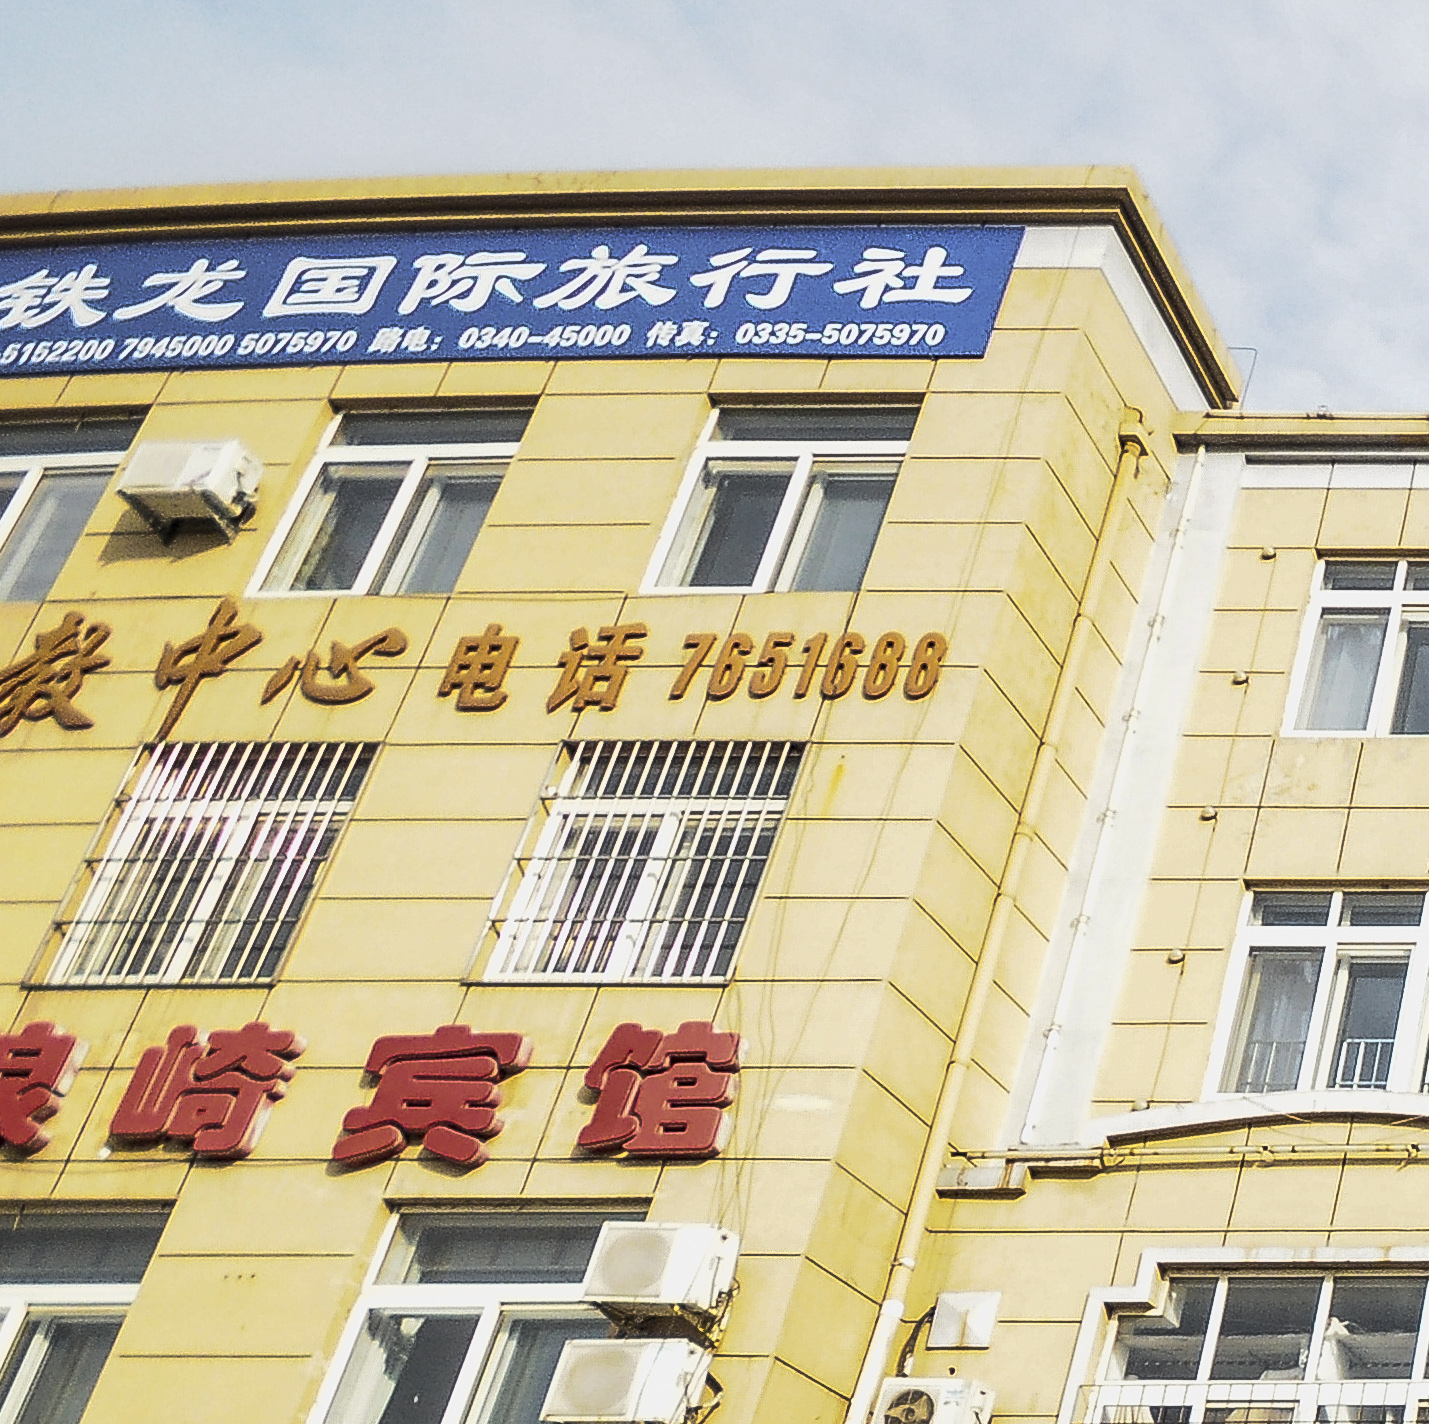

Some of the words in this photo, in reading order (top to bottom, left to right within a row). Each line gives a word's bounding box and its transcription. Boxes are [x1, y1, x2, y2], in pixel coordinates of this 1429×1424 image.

[0, 244, 975, 330] 铁龙国际旅行社
[119, 334, 235, 361] 7945000
[237, 330, 358, 356] 5075970
[458, 323, 632, 350] 0340-45000
[735, 322, 947, 347] 0335-5075970
[437, 622, 650, 714] 电话
[667, 631, 948, 702] 7651688
